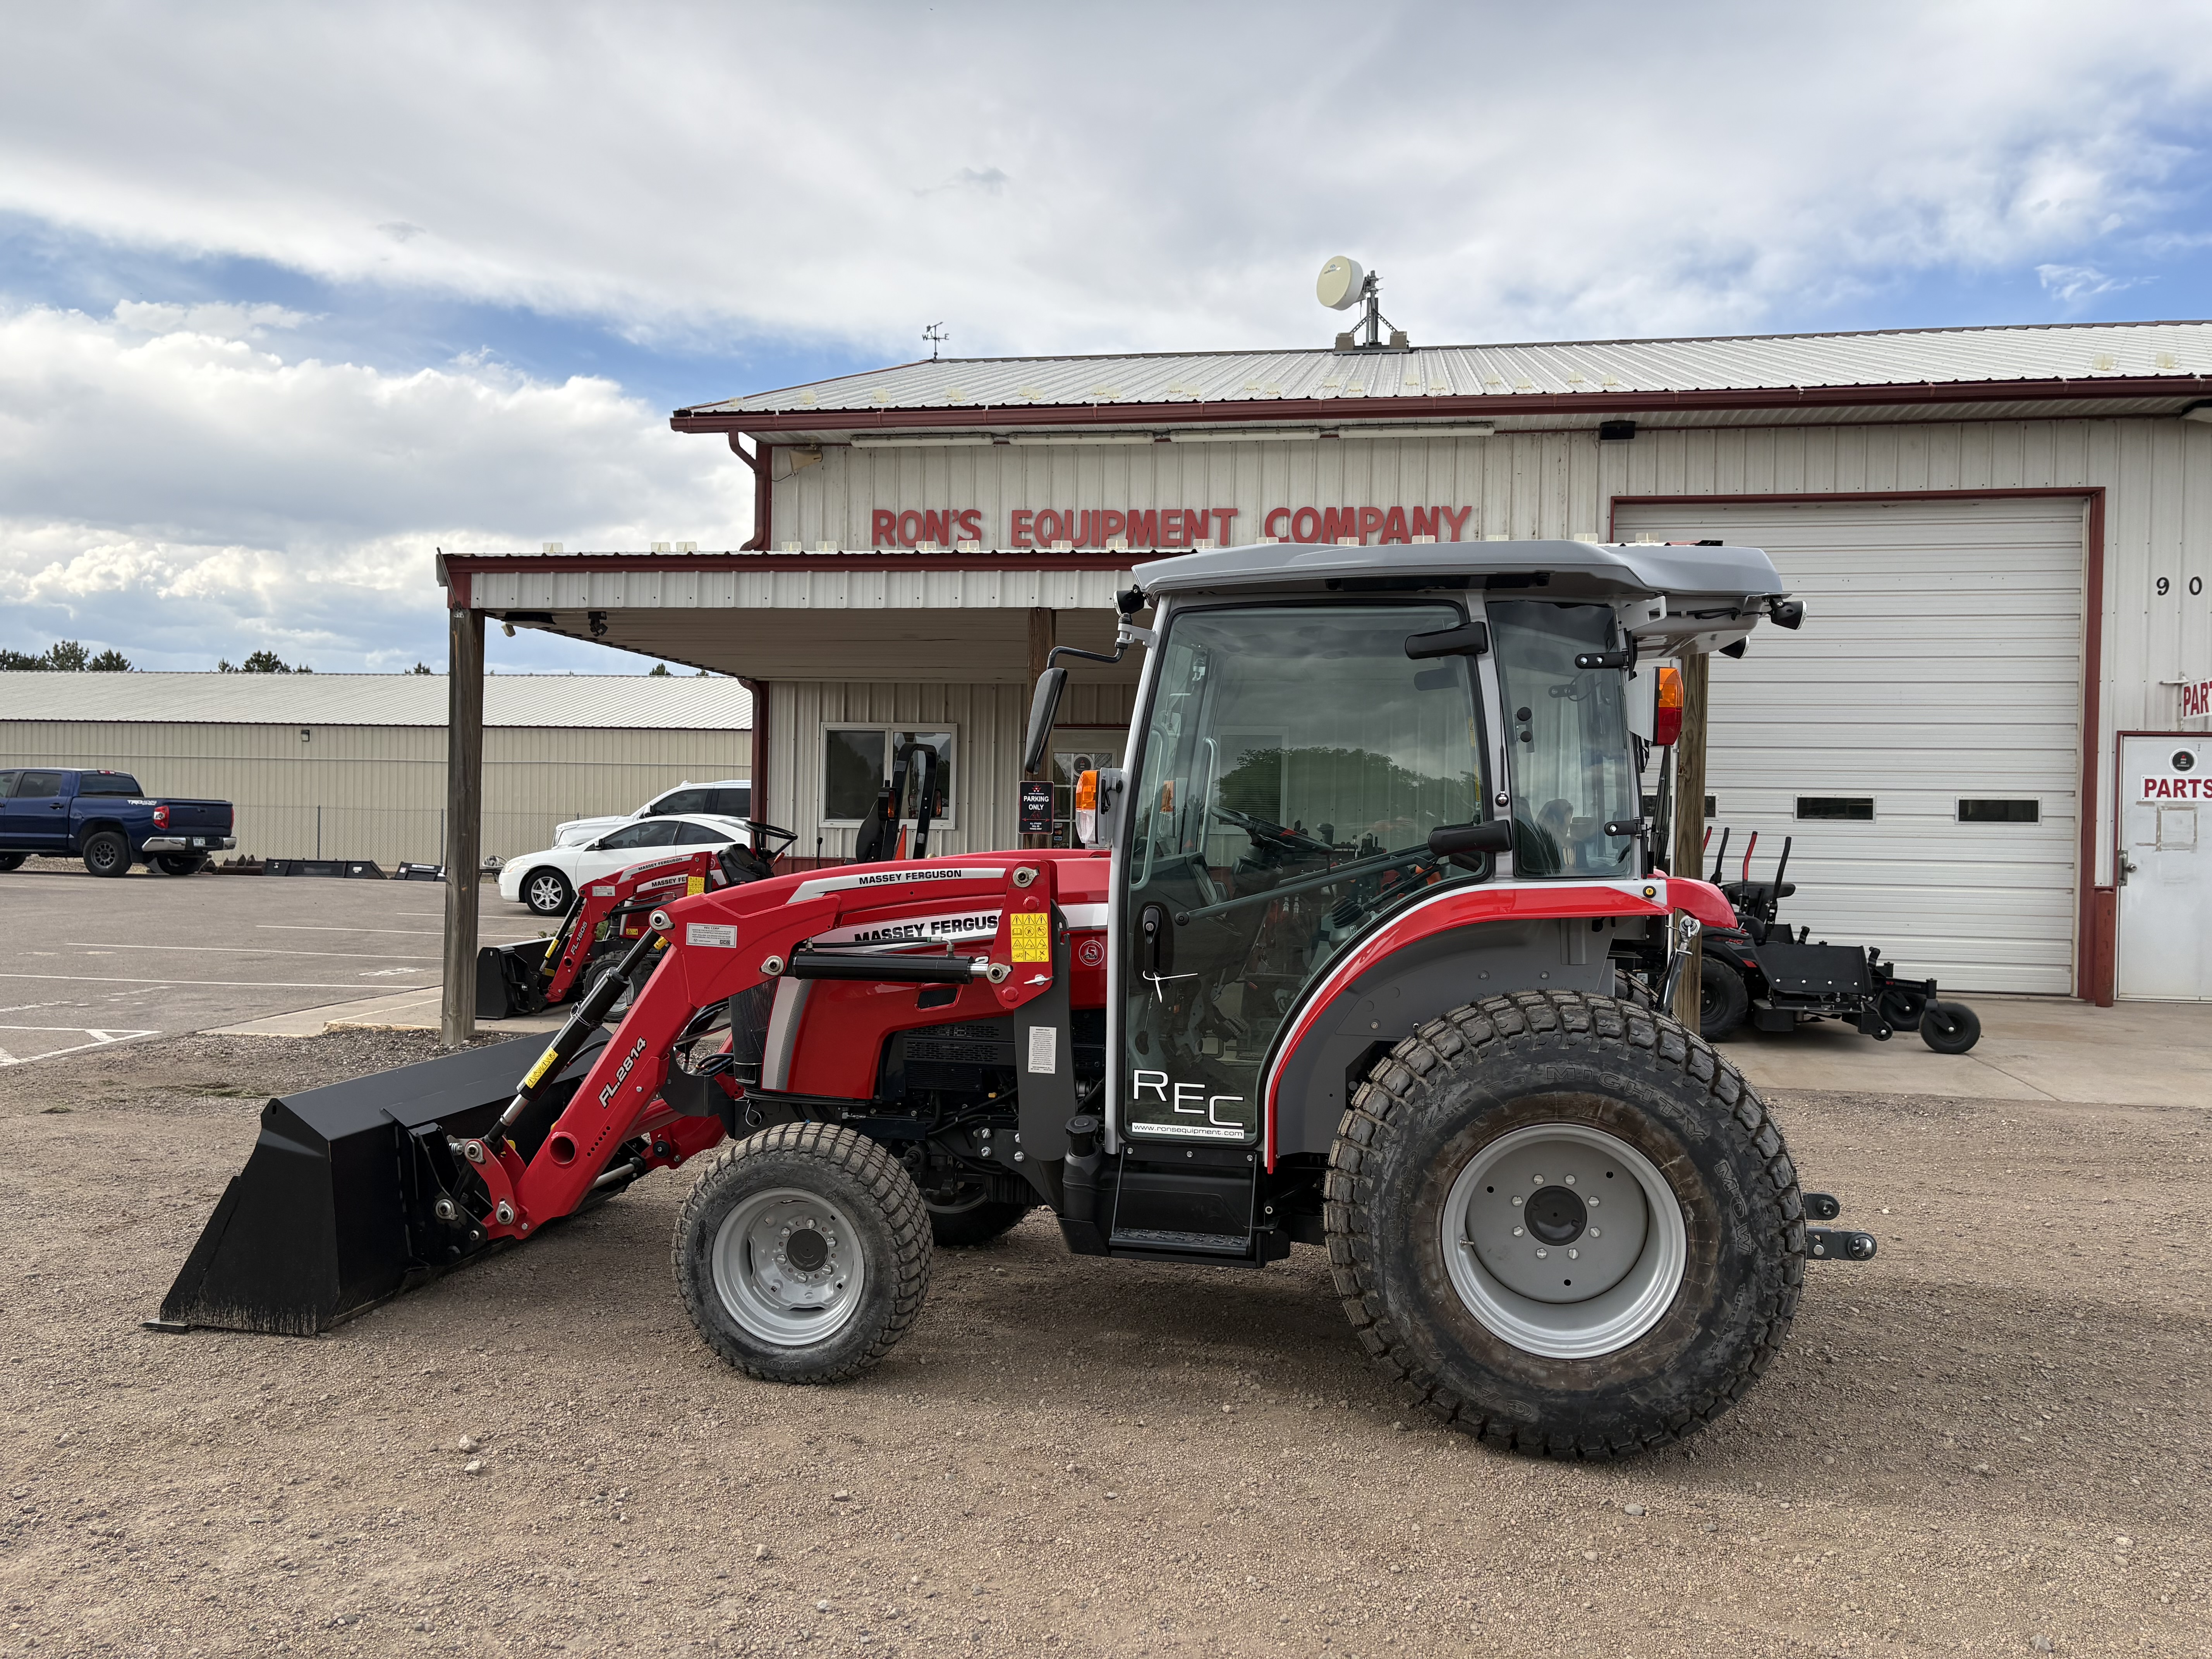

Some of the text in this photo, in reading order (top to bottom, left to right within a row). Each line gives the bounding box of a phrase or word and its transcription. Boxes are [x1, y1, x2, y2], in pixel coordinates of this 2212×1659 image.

[872, 506, 1472, 547] RON'S EQUIPMENT COMPANY
[2144, 778, 2212, 799] PARTS
[638, 857, 683, 871] MASSEY FERGUSON
[651, 878, 677, 888] MASSEY
[859, 869, 962, 884] MASSEY FERGUSON
[854, 915, 1001, 942] MASSEY FERGUS
[598, 1036, 647, 1108] FL.2814
[1133, 1069, 1244, 1127] REC
[1133, 1125, 1243, 1136] www.ronsequipment.com
[1546, 1066, 1707, 1138] MIGHTY
[1714, 1161, 1751, 1253] MOW
[750, 1355, 801, 1370] MOW
